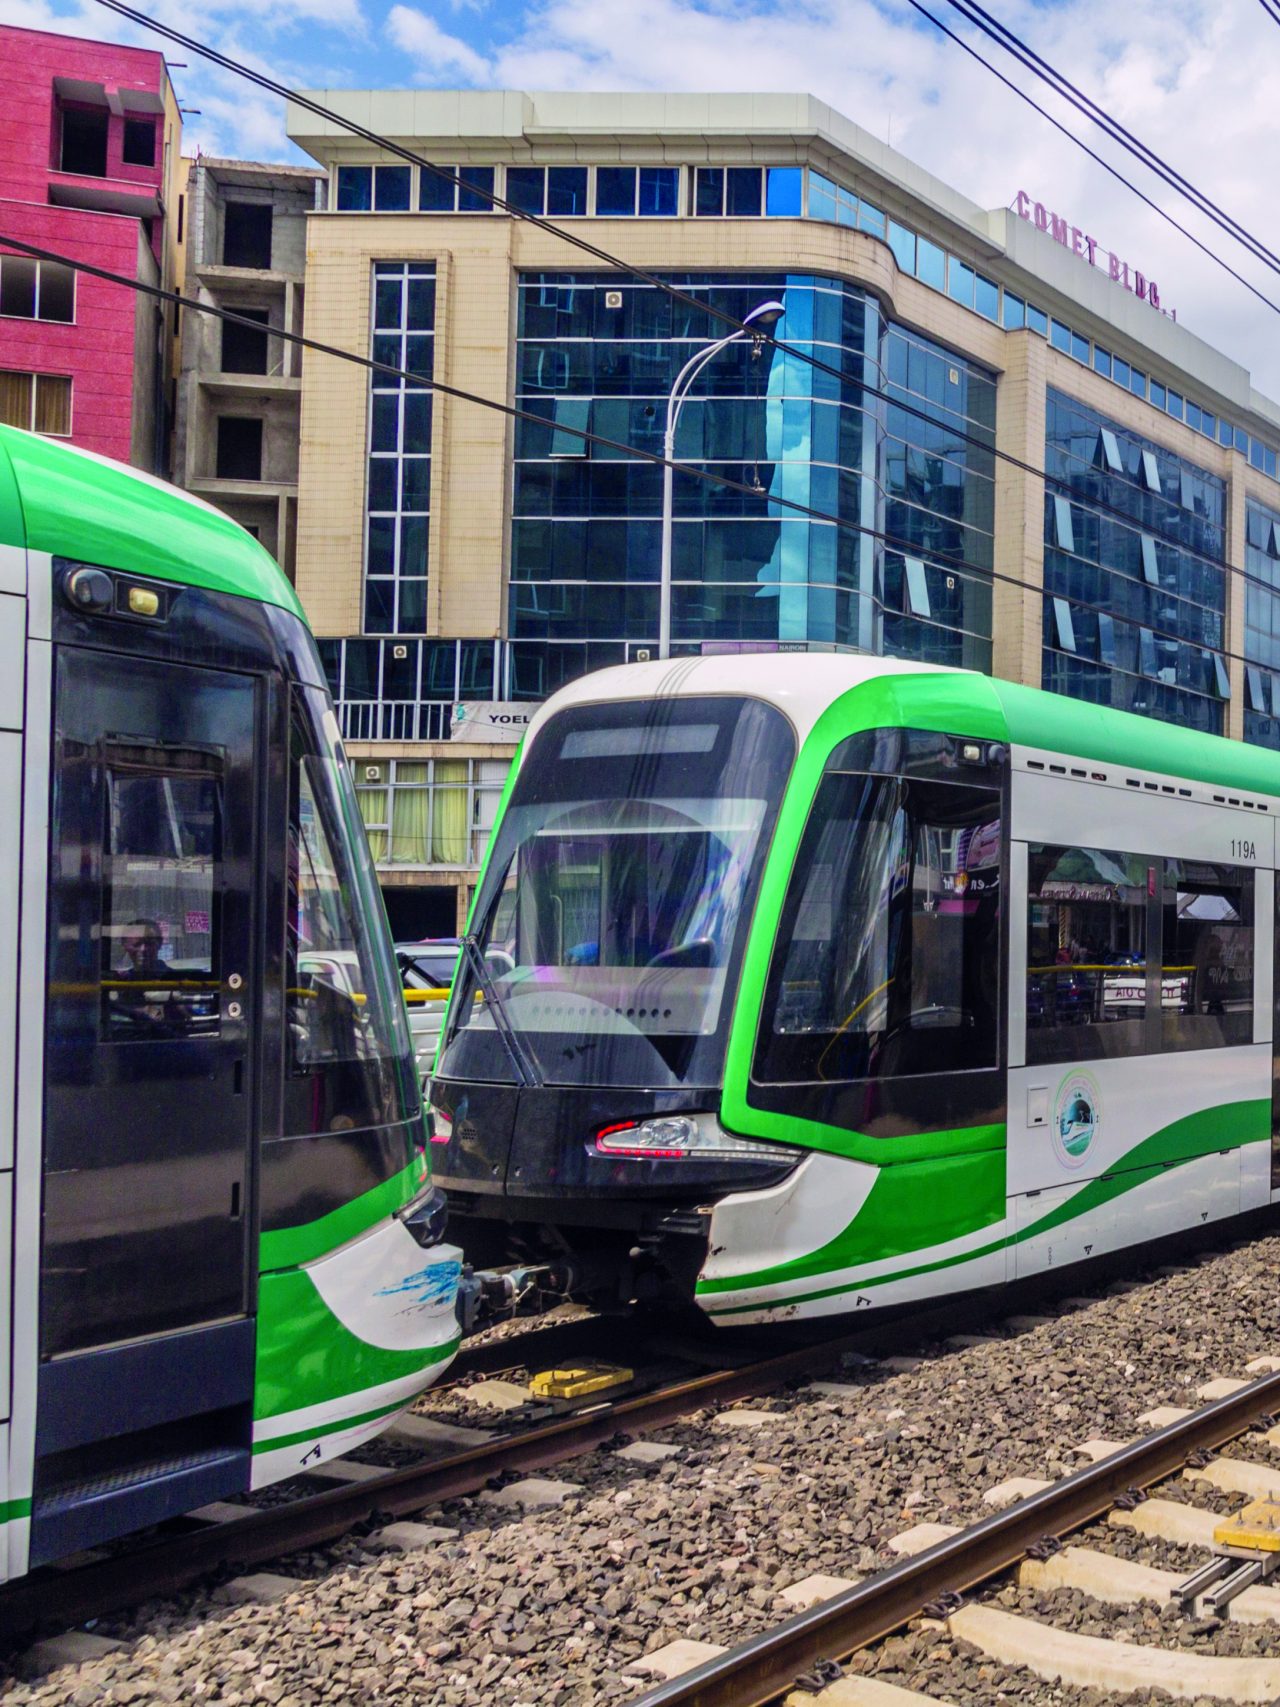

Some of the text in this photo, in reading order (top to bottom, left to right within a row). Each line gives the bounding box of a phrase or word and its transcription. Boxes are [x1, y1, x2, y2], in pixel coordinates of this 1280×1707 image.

[1017, 190, 1097, 266] COMET
[489, 714, 530, 724] YOEL
[1231, 839, 1256, 860] 119A
